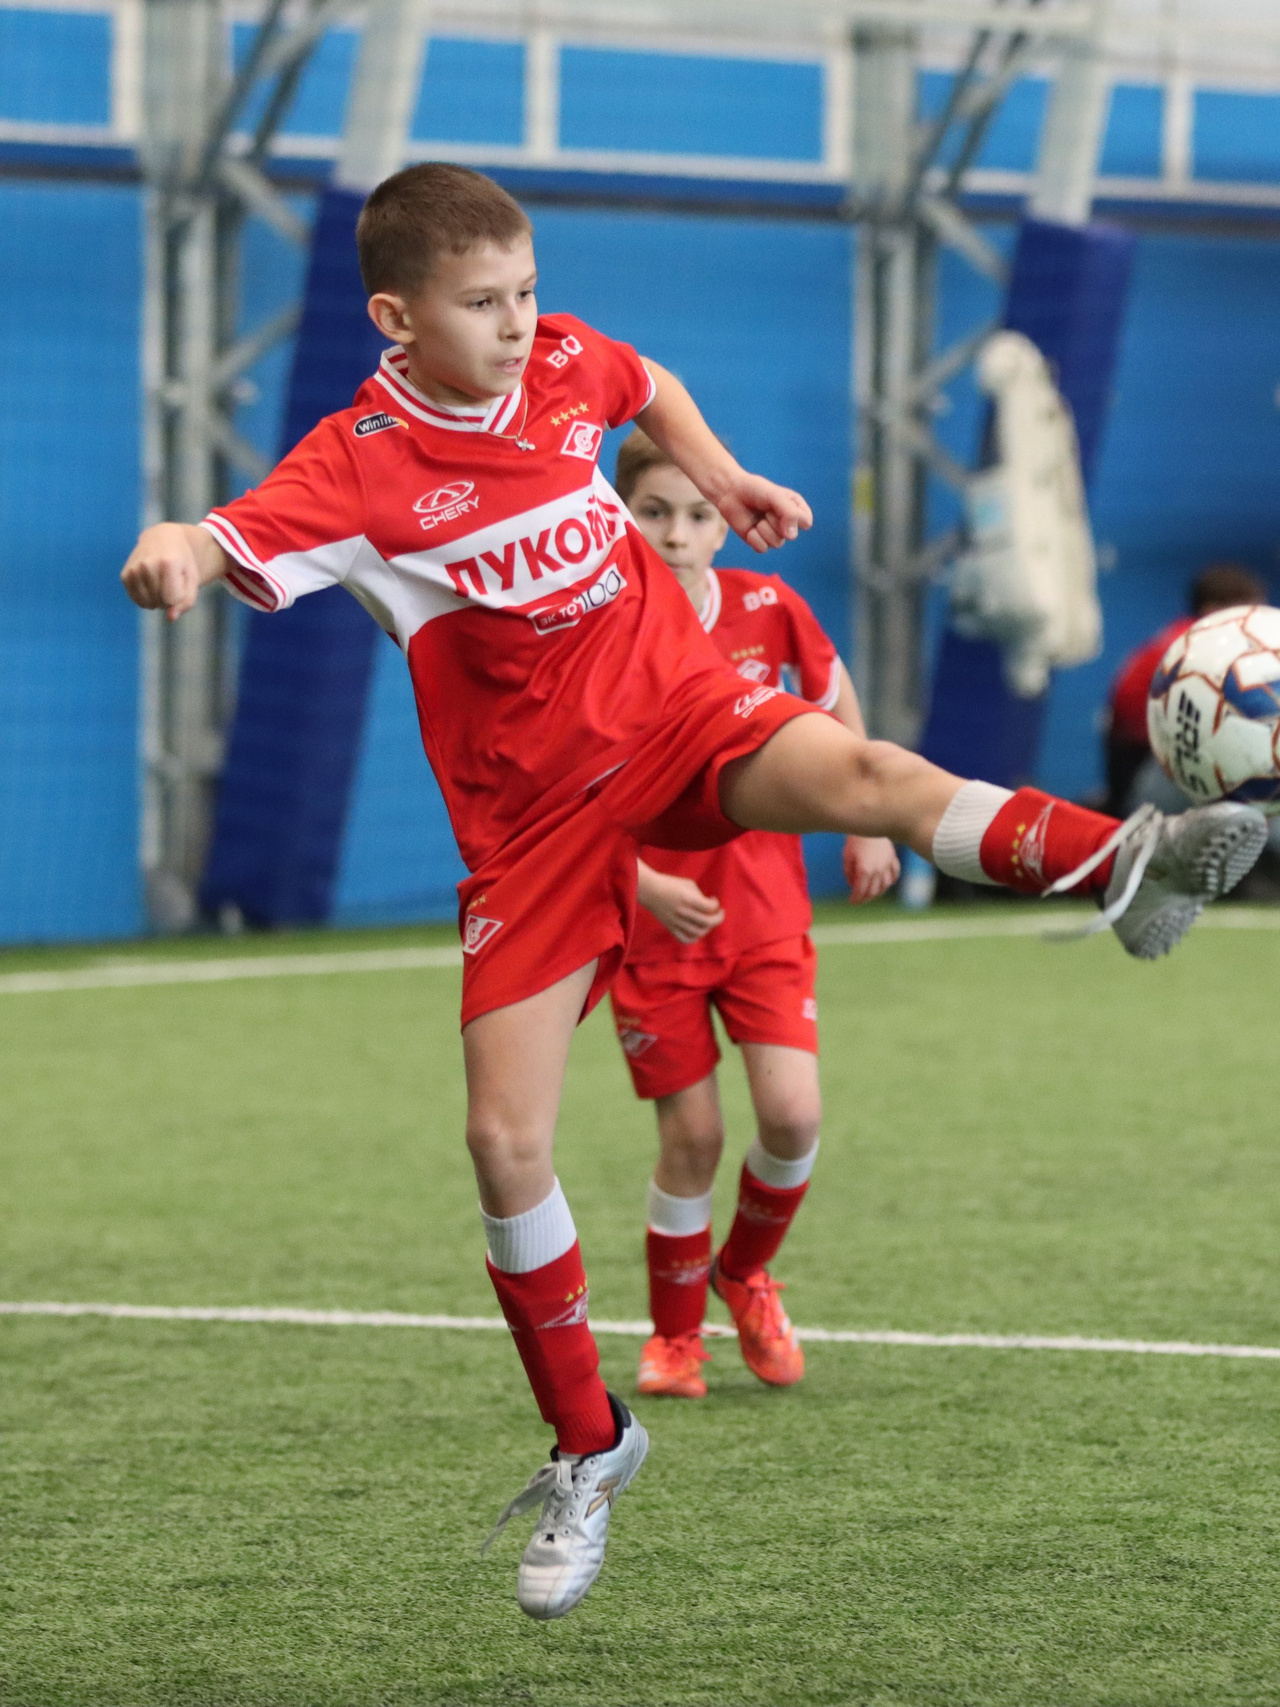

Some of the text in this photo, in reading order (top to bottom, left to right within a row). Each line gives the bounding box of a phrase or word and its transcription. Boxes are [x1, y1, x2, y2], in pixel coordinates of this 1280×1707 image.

[546, 335, 584, 368] BQ
[358, 414, 398, 433] Winlin
[419, 495, 480, 531] CHERY
